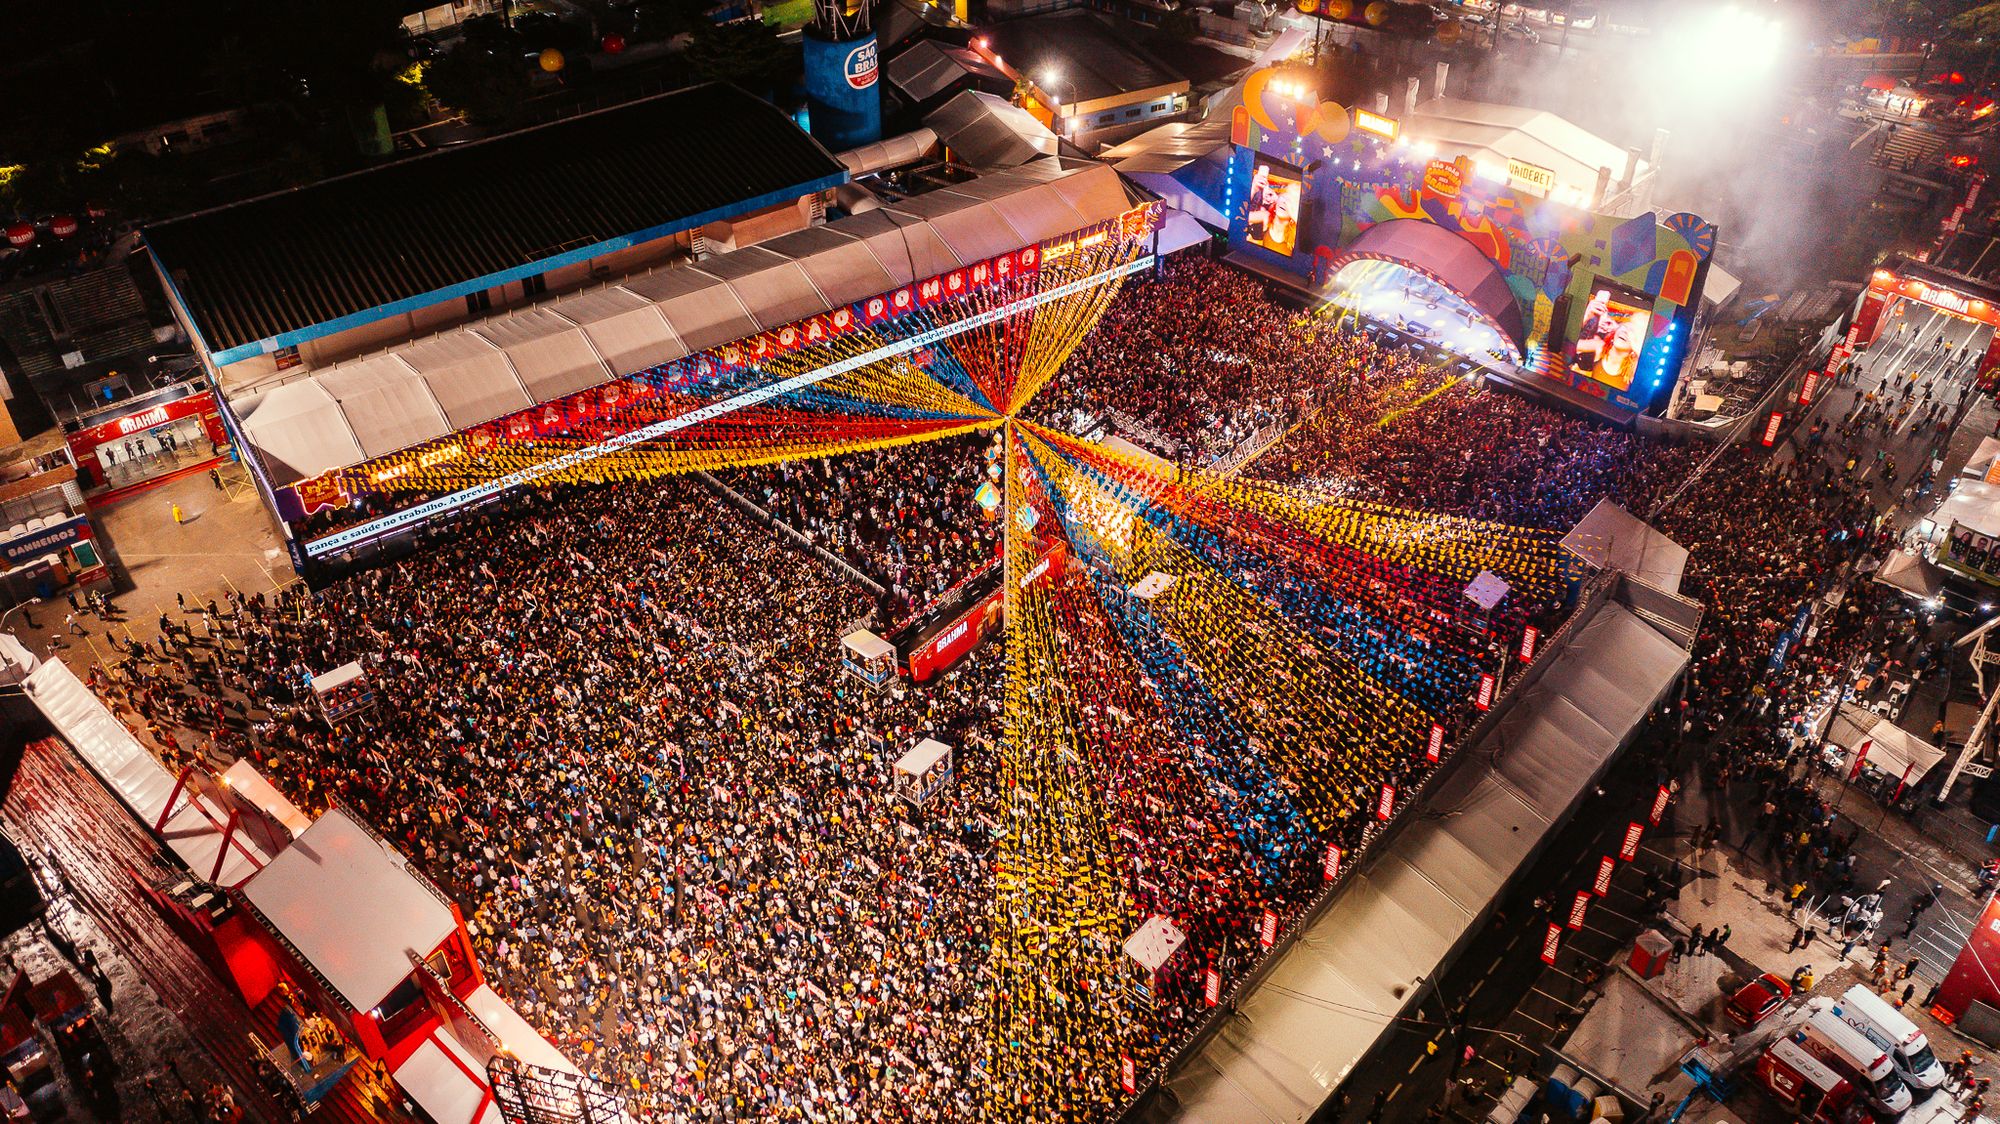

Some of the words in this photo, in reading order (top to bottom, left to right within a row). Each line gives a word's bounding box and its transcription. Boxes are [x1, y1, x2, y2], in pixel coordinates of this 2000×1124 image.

[1509, 163, 1550, 186] VAIDEBET
[1919, 287, 1970, 314] BRAHMA
[1802, 373, 1818, 400] BRAHMA
[119, 405, 170, 434] BRAHMA
[1765, 415, 1782, 442] BRAHMA
[350, 521, 381, 538] saúde
[383, 517, 397, 527] no
[399, 500, 447, 523] trabalho.
[8, 528, 76, 557] BANHEIROS
[936, 620, 968, 653] BRAHMA
[1522, 628, 1536, 658] BRAHMA
[1478, 677, 1494, 707] BRAHMA
[1428, 726, 1443, 757] BRAHMA
[1380, 787, 1393, 817] BRAHMA
[1623, 826, 1642, 856] BRAHMA
[1326, 846, 1340, 877] BRAHMA
[1595, 861, 1613, 893] BRAHMA
[1570, 896, 1588, 926] BRAHMA
[1262, 912, 1277, 946] BRAHMA
[1544, 927, 1560, 960] BRAHMA
